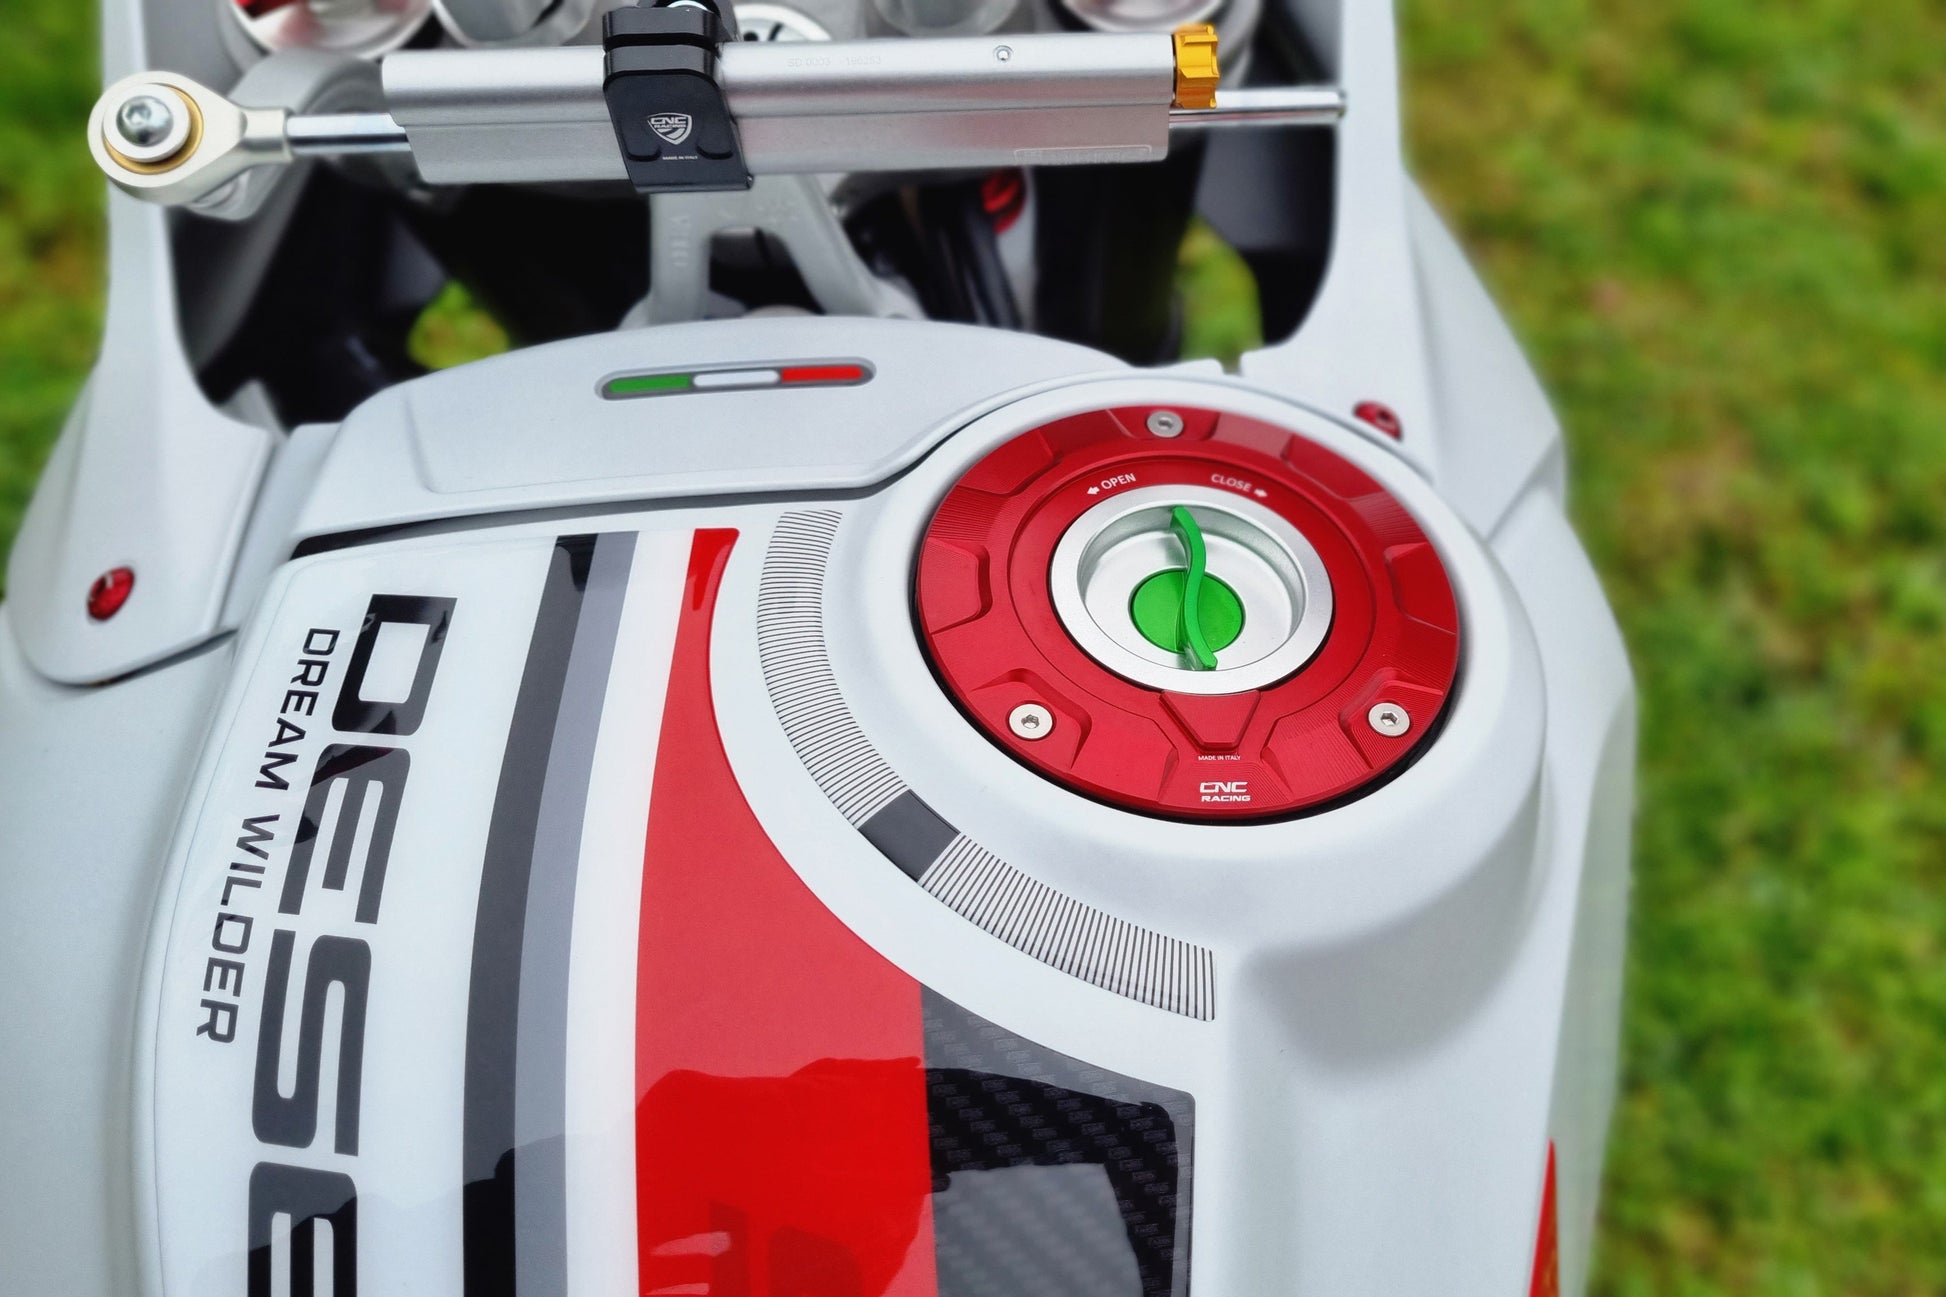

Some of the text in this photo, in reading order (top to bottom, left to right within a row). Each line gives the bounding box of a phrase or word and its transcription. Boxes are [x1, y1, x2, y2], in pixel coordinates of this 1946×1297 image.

[1101, 473, 1137, 490] OPEN
[1210, 473, 1252, 493] CLOSE
[1199, 781, 1248, 793] CNC
[196, 628, 340, 1044] DREAM WILDER
